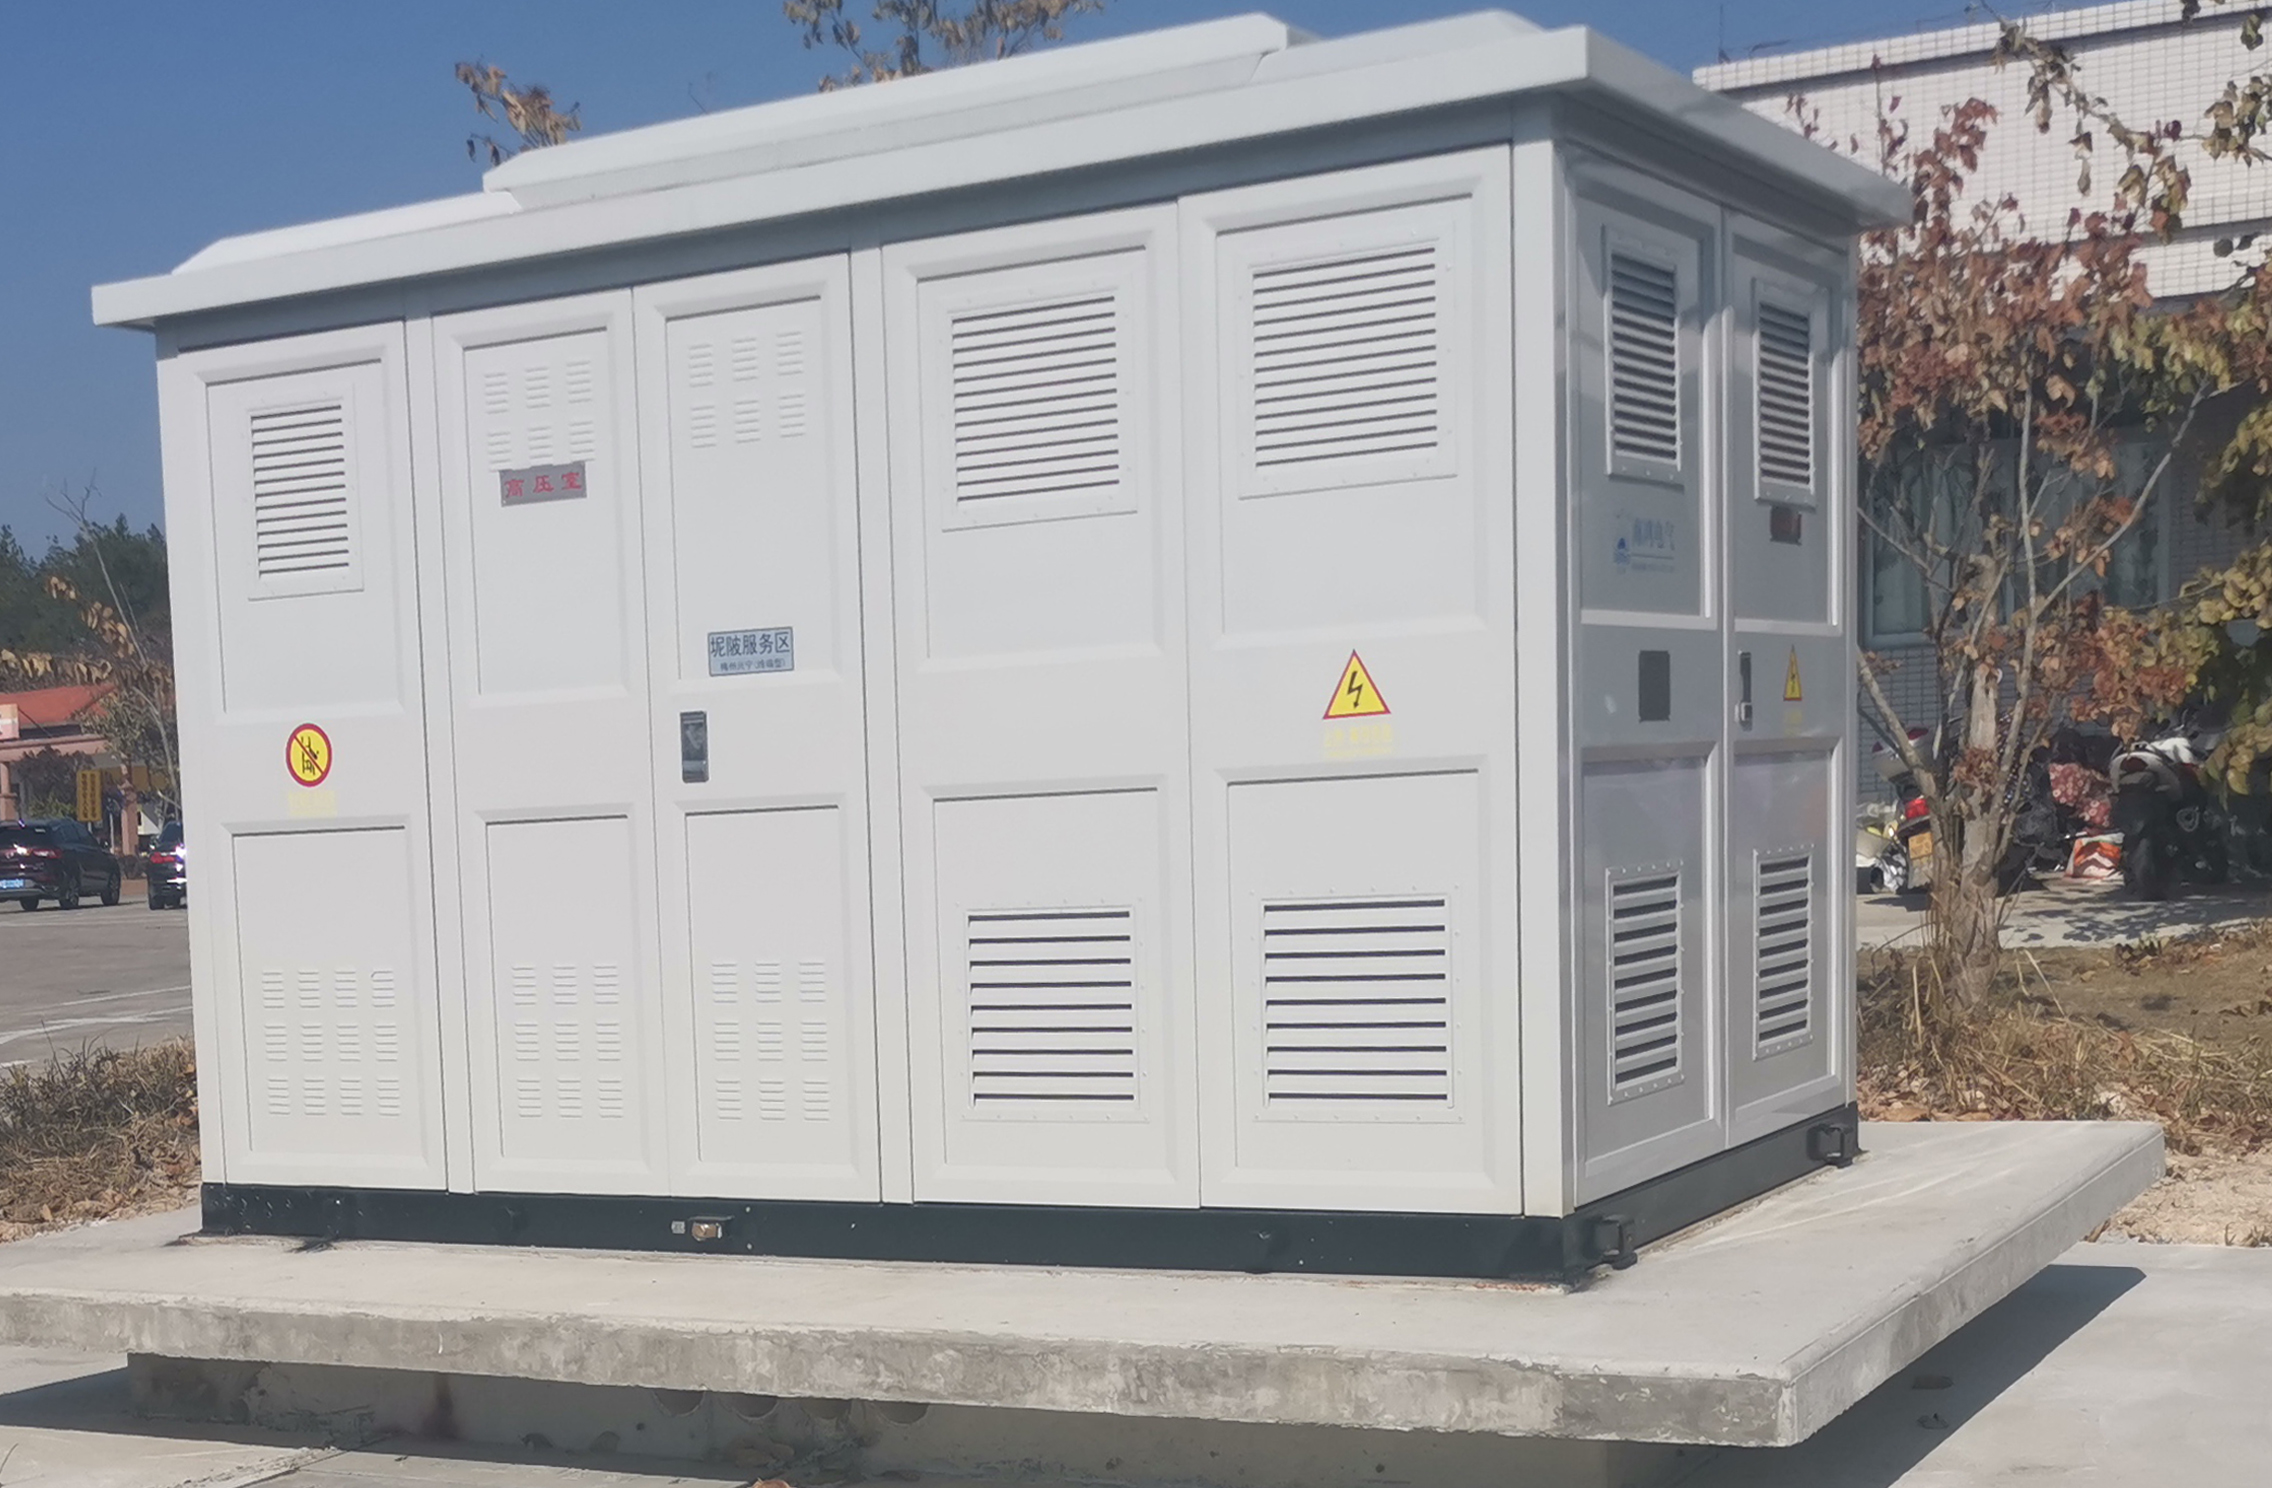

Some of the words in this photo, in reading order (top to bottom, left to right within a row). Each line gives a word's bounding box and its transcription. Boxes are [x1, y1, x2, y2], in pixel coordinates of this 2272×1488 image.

[503, 472, 583, 498] 高压室
[710, 631, 790, 658] 坭陂服务区
